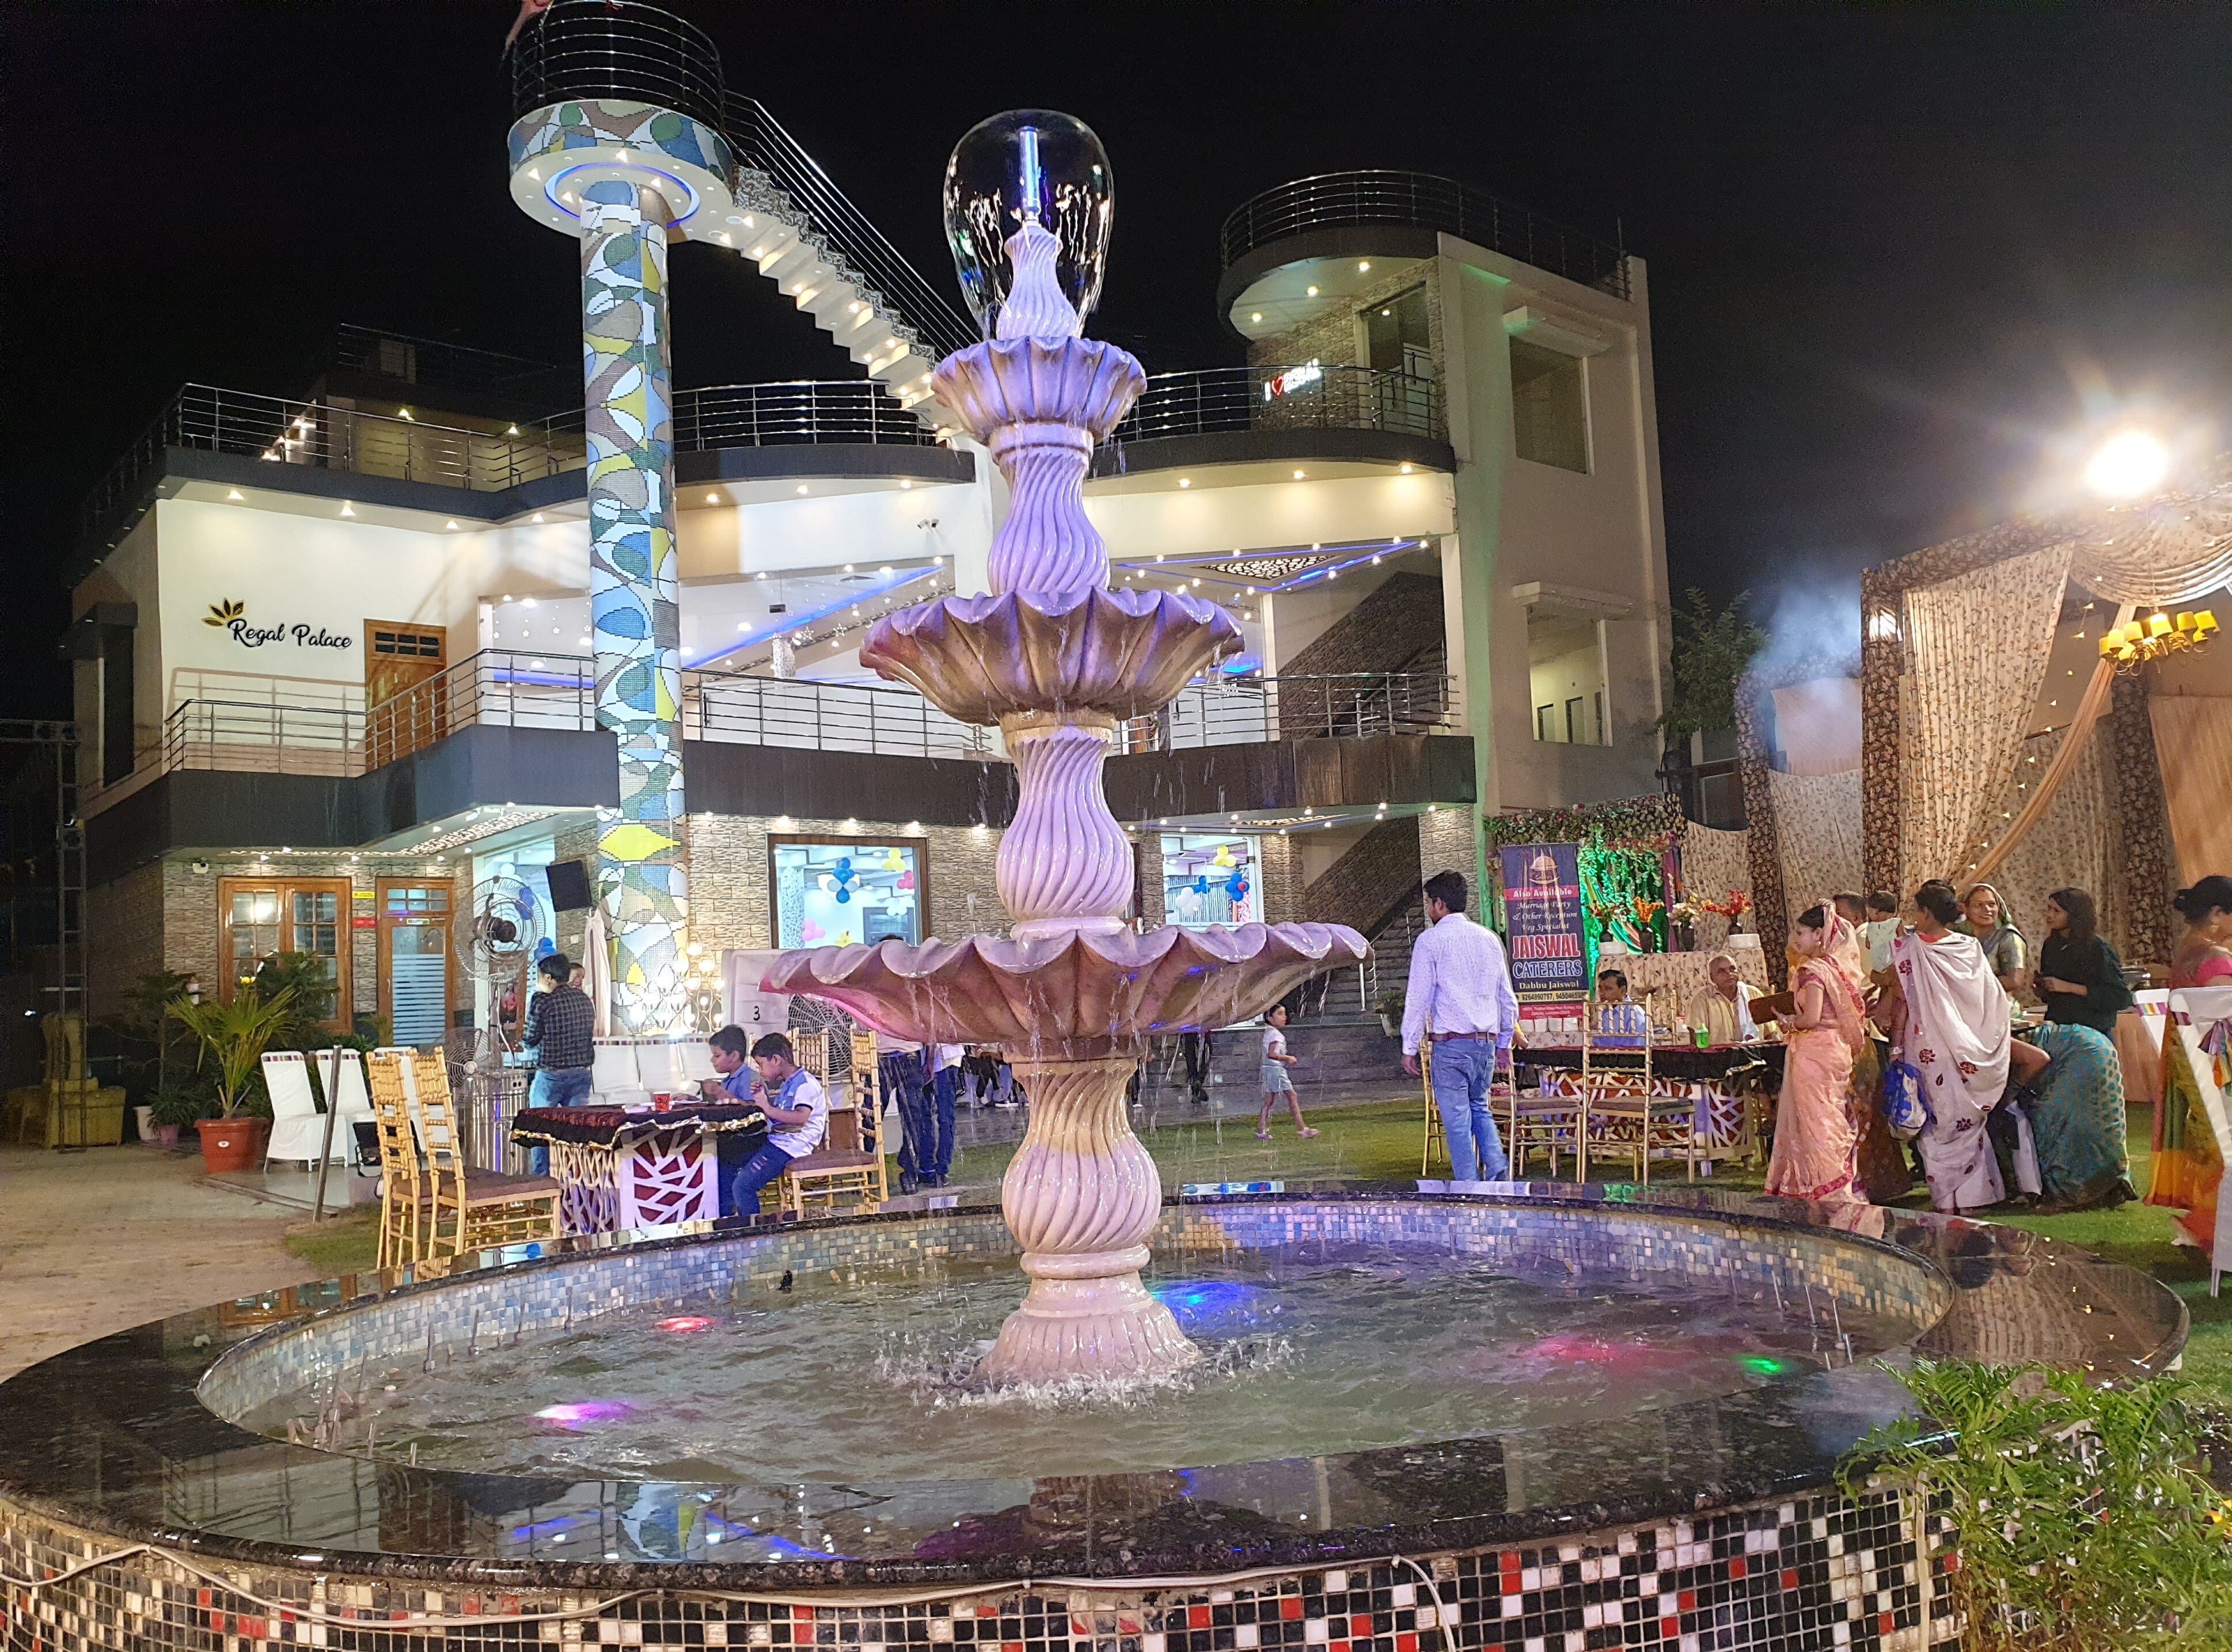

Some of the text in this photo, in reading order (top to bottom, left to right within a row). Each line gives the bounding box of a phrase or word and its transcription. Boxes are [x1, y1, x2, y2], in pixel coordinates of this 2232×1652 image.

[227, 618, 352, 650] Regal Palace
[1513, 887, 1572, 898] Also Available
[1512, 933, 1581, 959] JAISWAL
[1512, 960, 1582, 978] CATERERS
[1548, 980, 1579, 989] Jaiswal
[753, 1005, 760, 1021] 3
